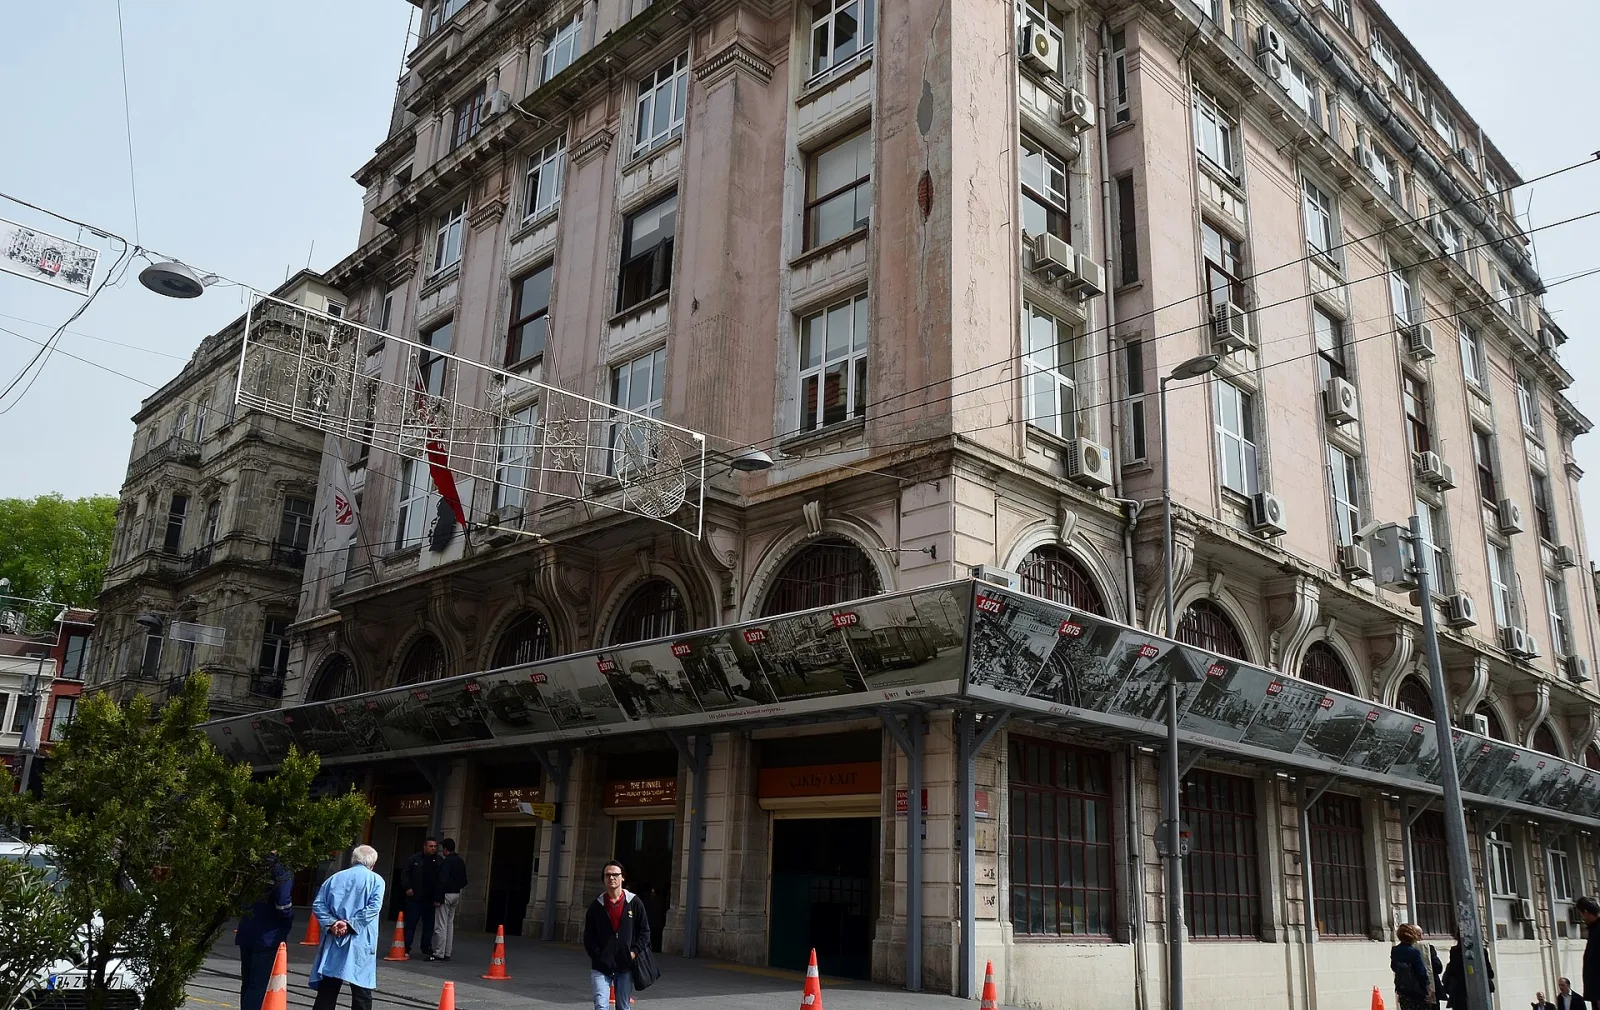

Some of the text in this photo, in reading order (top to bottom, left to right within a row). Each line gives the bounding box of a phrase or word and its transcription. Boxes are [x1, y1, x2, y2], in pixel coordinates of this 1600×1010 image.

[978, 599, 1001, 613] 1871
[836, 613, 858, 628] 1979
[1061, 623, 1080, 637] 1875
[747, 630, 767, 643] 1971
[674, 644, 692, 656] 1971
[1141, 646, 1158, 657] 1897
[599, 660, 615, 671] 1970
[1209, 666, 1224, 676] 1910
[829, 771, 858, 785] EXIT
[641, 780, 662, 789] TUNNEL
